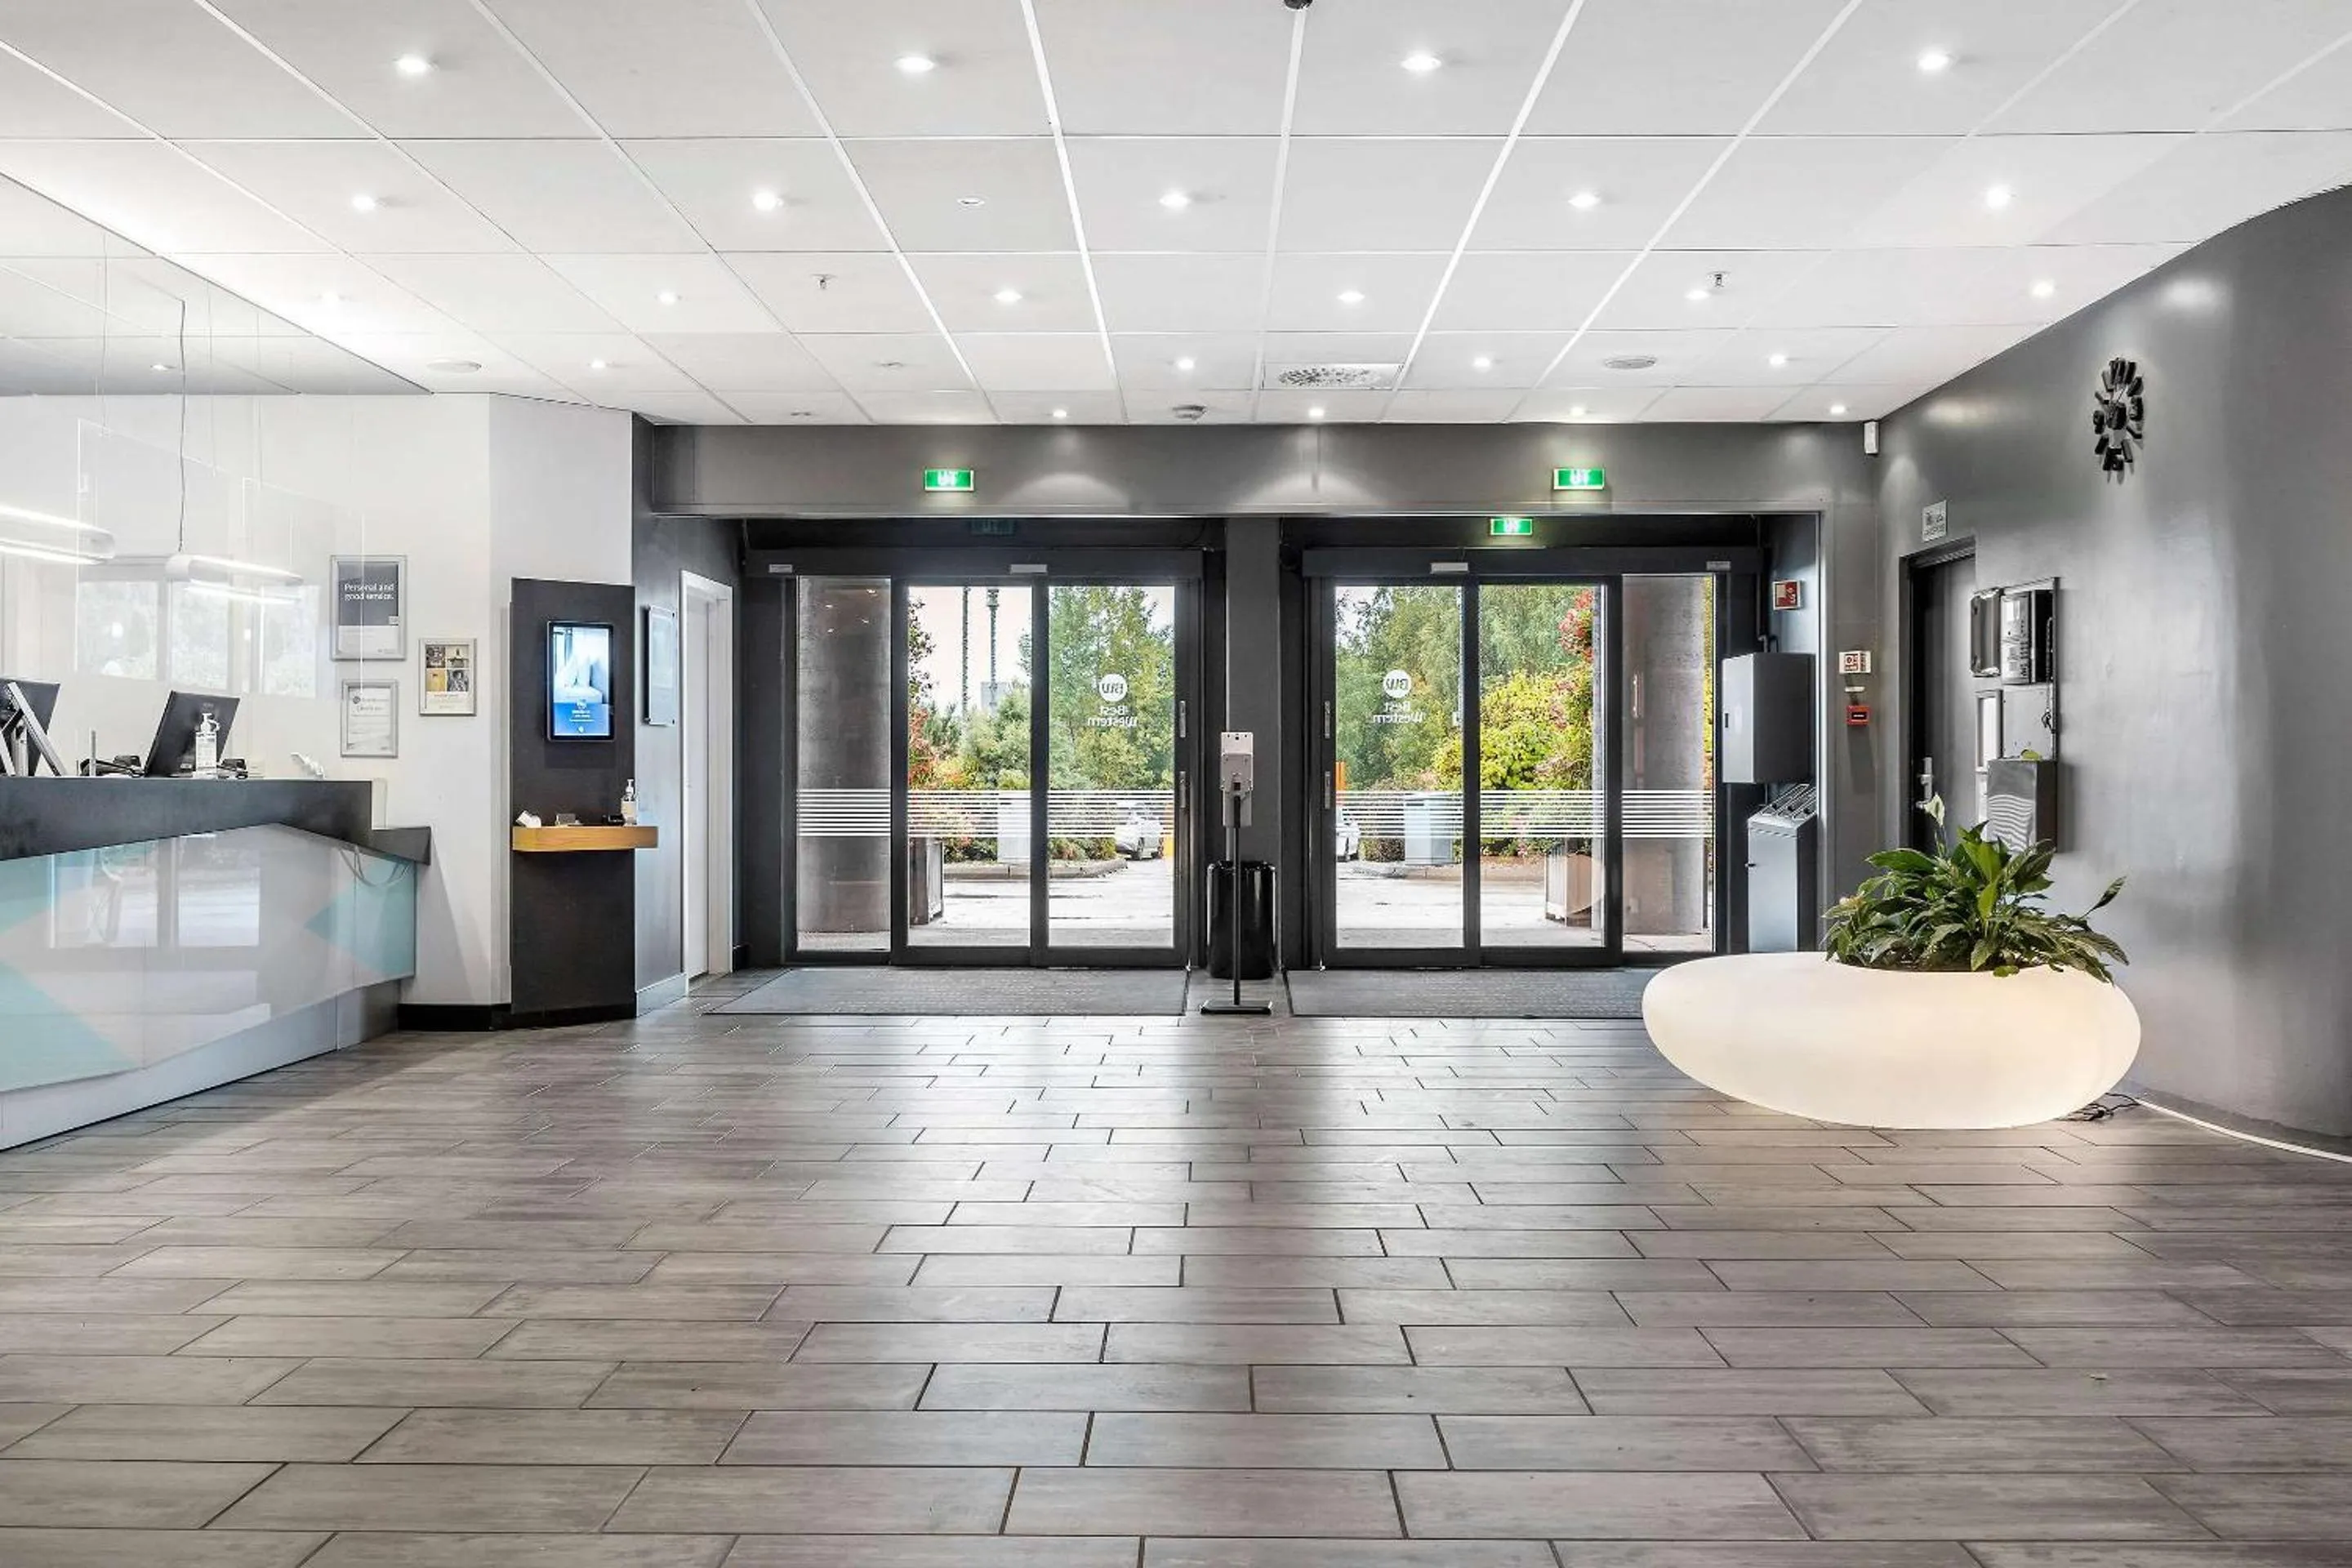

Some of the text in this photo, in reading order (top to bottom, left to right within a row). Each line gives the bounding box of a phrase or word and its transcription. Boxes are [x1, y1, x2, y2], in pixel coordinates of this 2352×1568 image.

[345, 582, 394, 592] Personal and
[345, 593, 364, 601] good
